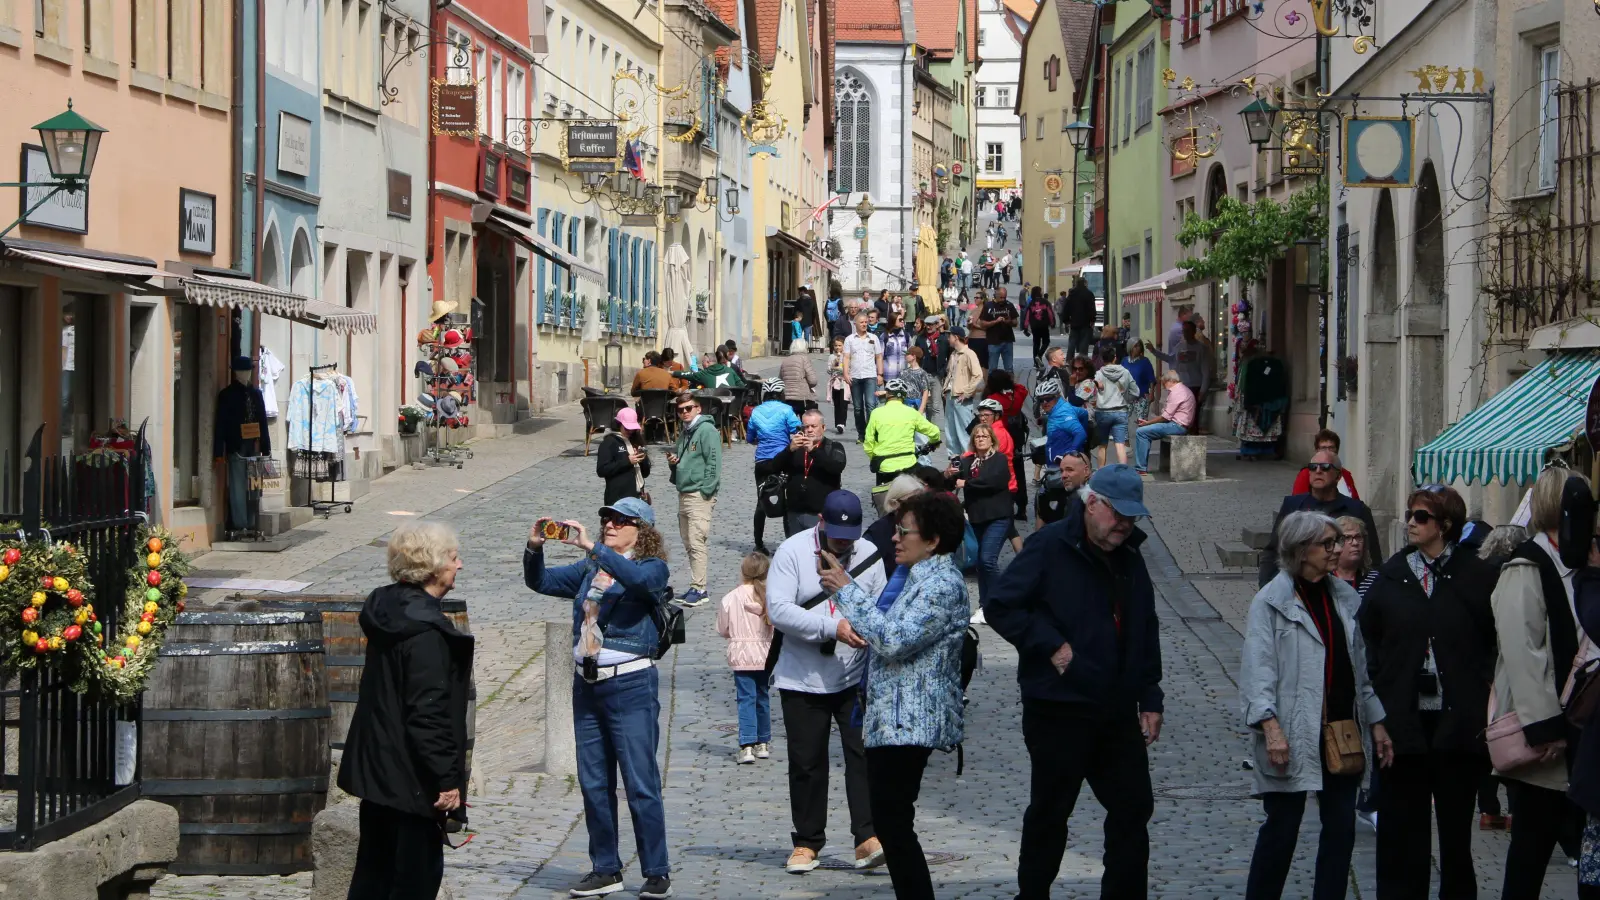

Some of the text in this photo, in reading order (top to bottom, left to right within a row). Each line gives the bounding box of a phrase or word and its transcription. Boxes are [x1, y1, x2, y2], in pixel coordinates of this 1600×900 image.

[571, 131, 613, 140] Restaurant
[184, 207, 206, 243] MANN
[250, 476, 280, 491] MANN
